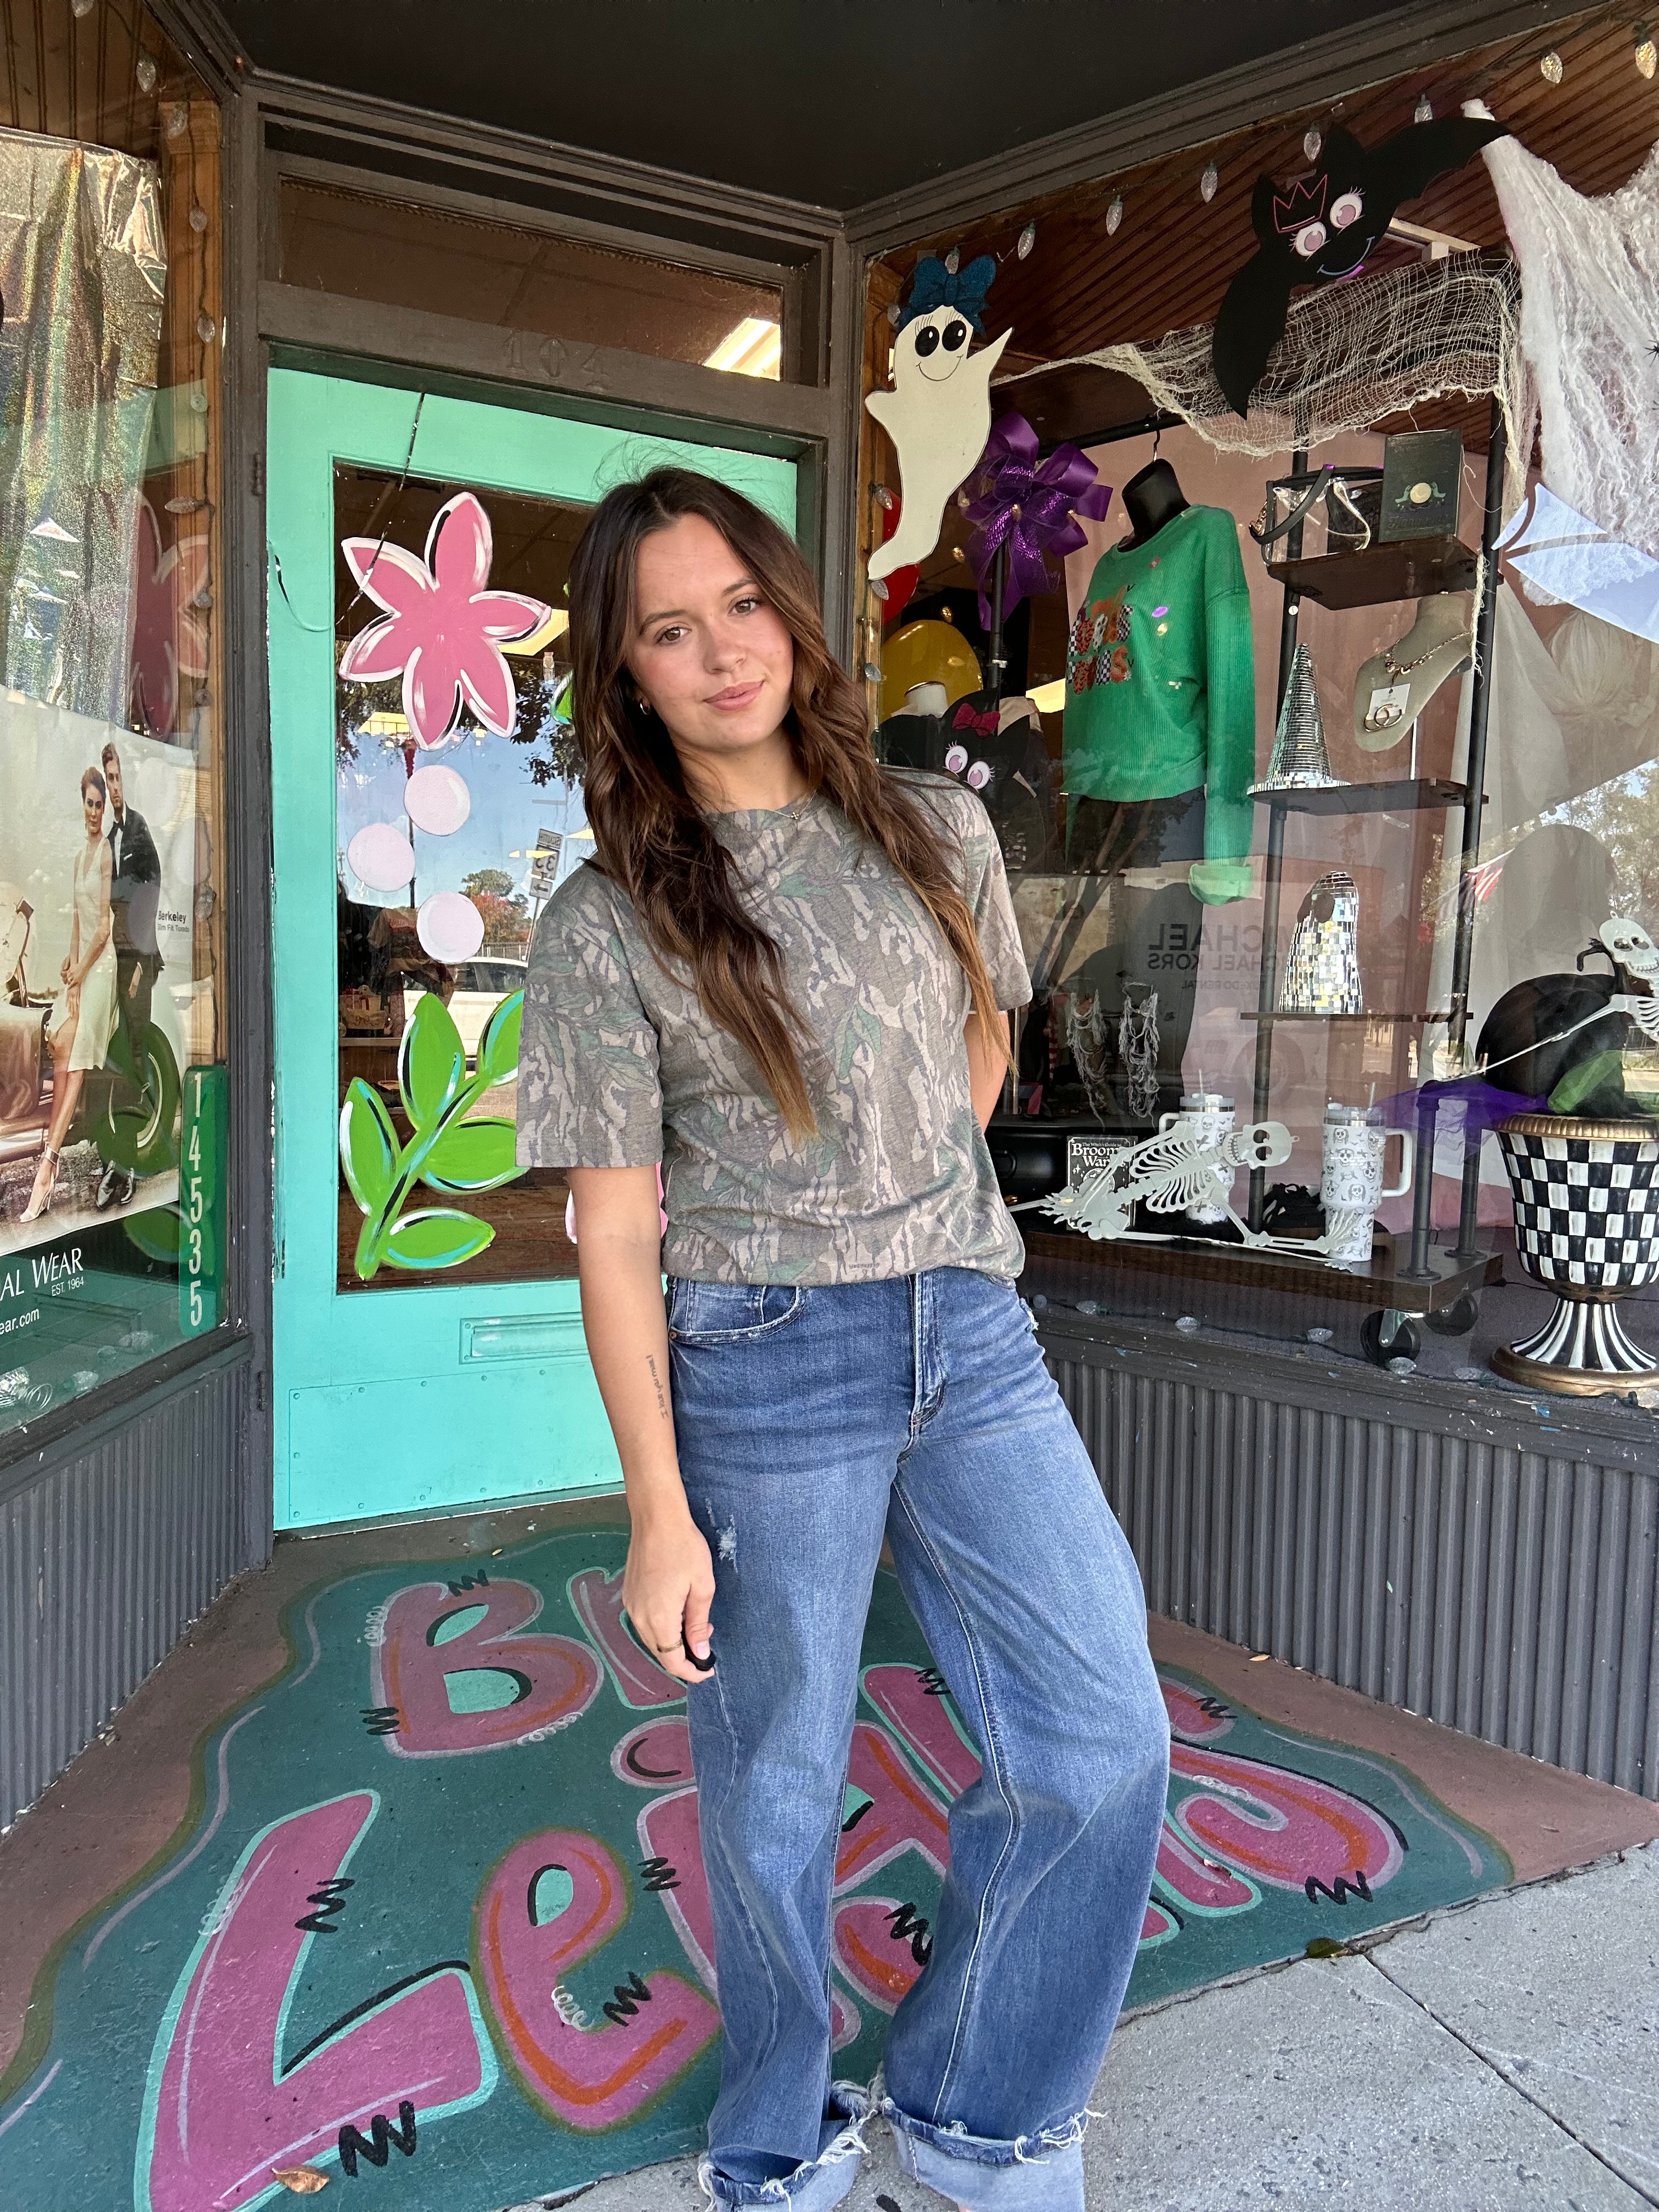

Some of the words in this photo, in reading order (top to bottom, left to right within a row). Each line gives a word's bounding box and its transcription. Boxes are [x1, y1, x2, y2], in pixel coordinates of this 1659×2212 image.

[158, 910, 187, 924] Berkeley
[188, 1071, 203, 1327] 14535
[31, 1247, 83, 1288] WEAR
[67, 1276, 84, 1290] 1964
